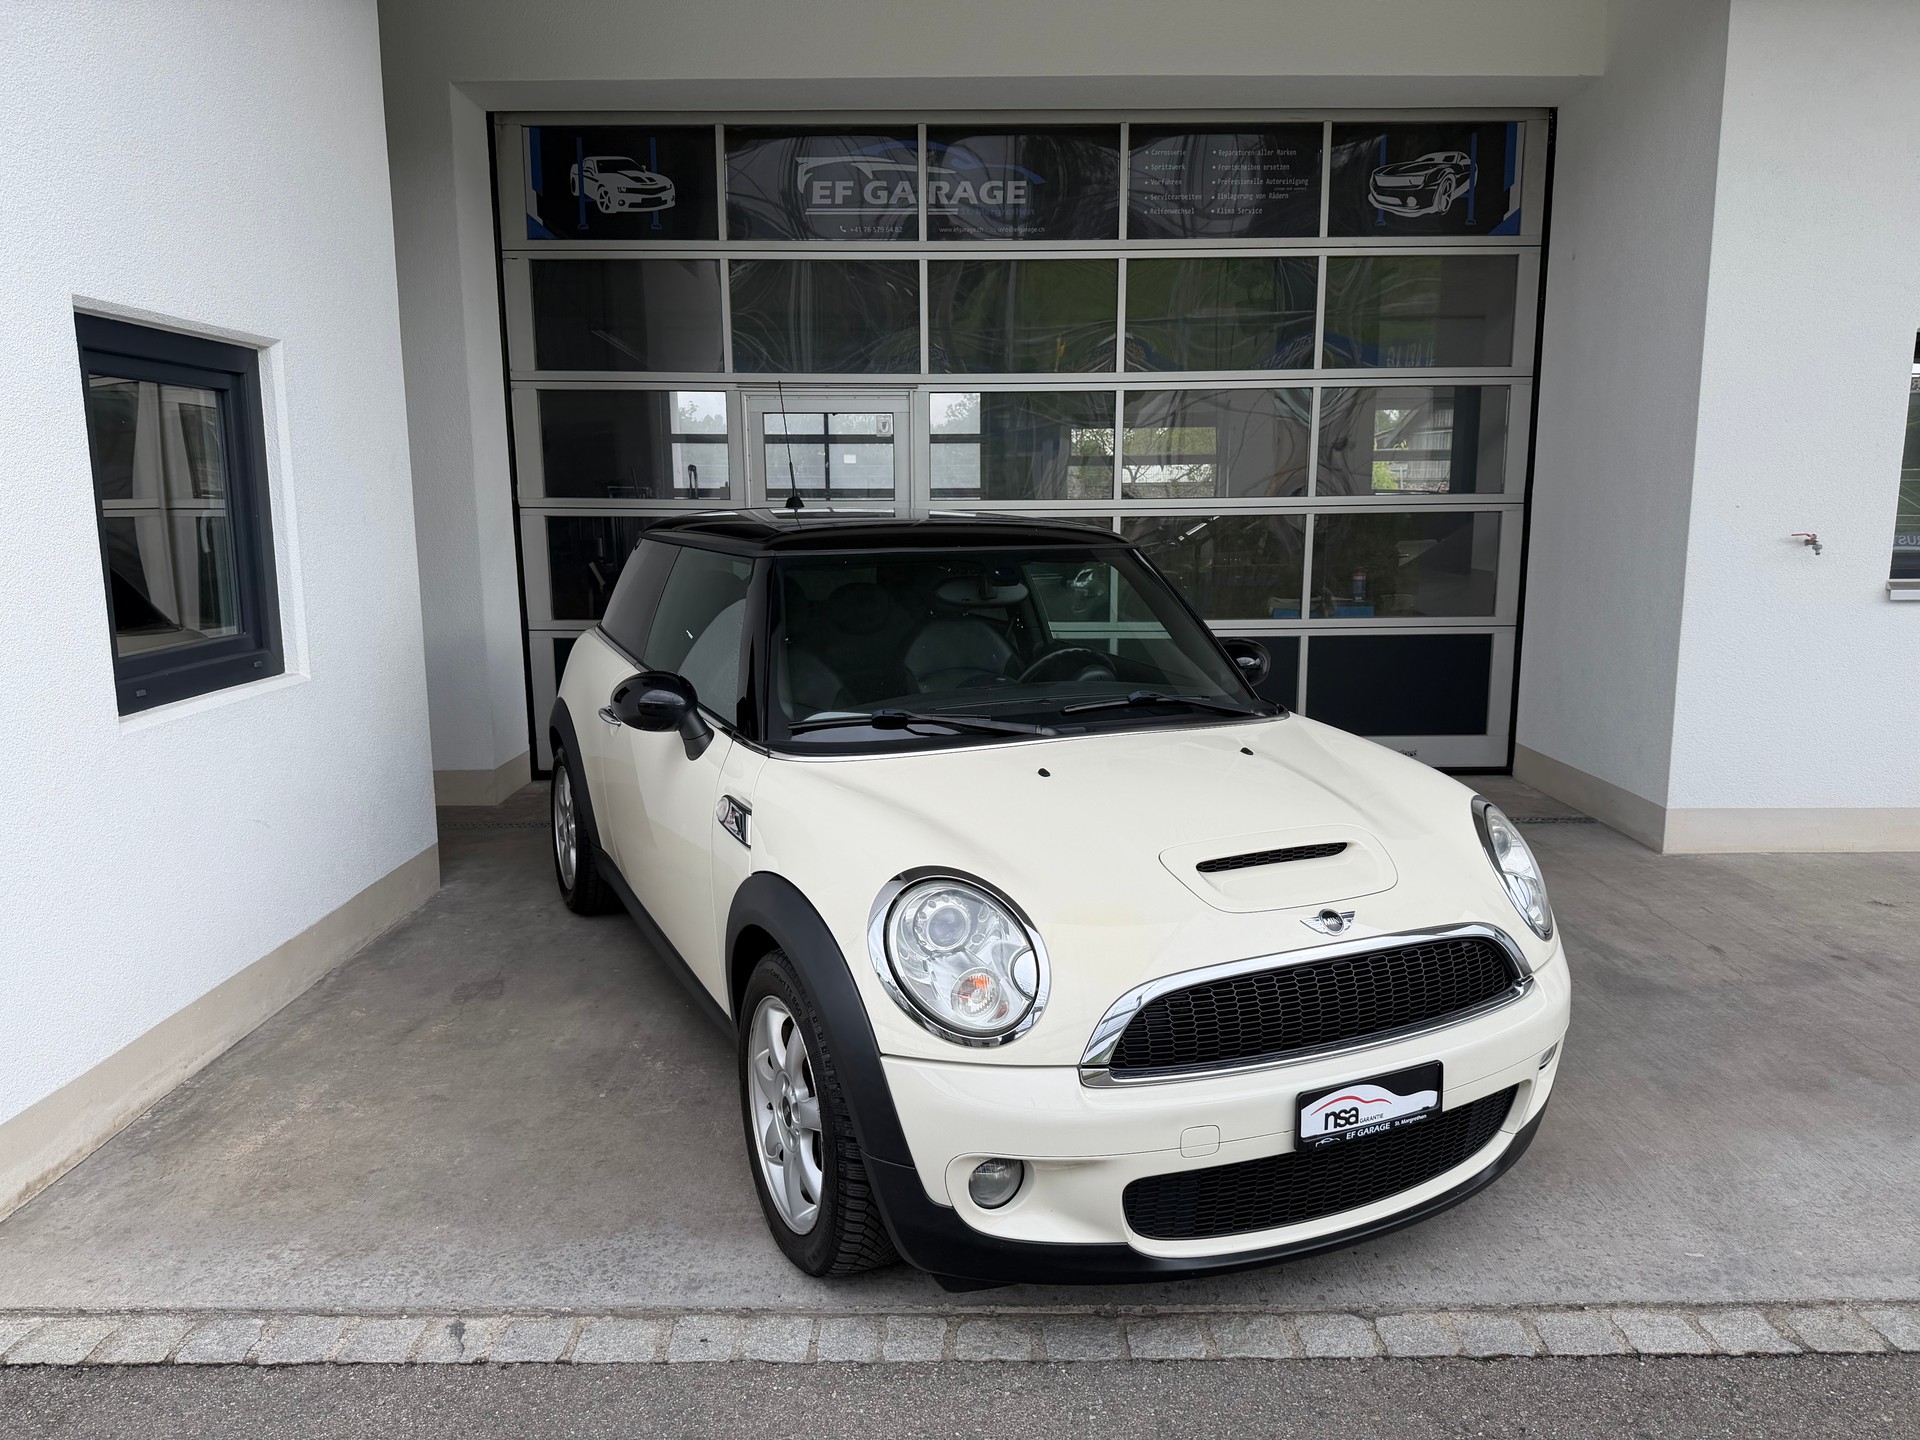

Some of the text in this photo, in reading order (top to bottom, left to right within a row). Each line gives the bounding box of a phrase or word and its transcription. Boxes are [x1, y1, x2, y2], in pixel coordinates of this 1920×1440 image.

[1218, 149, 1255, 157] Reparaturen
[1266, 178, 1309, 186] Autoreinigung
[812, 180, 1027, 205] EF GARAGE
[1150, 193, 1203, 201] Servicearbeiten
[1217, 192, 1254, 201] Einlagerung
[1150, 207, 1194, 215] Reifenwechsel
[1216, 207, 1263, 215] Klima Service
[1323, 917, 1342, 926] MINI
[1324, 1106, 1359, 1131] nsa
[1359, 1112, 1385, 1124] GARANTIE
[1346, 1131, 1357, 1140] EF
[1357, 1122, 1391, 1137] GARAGE
